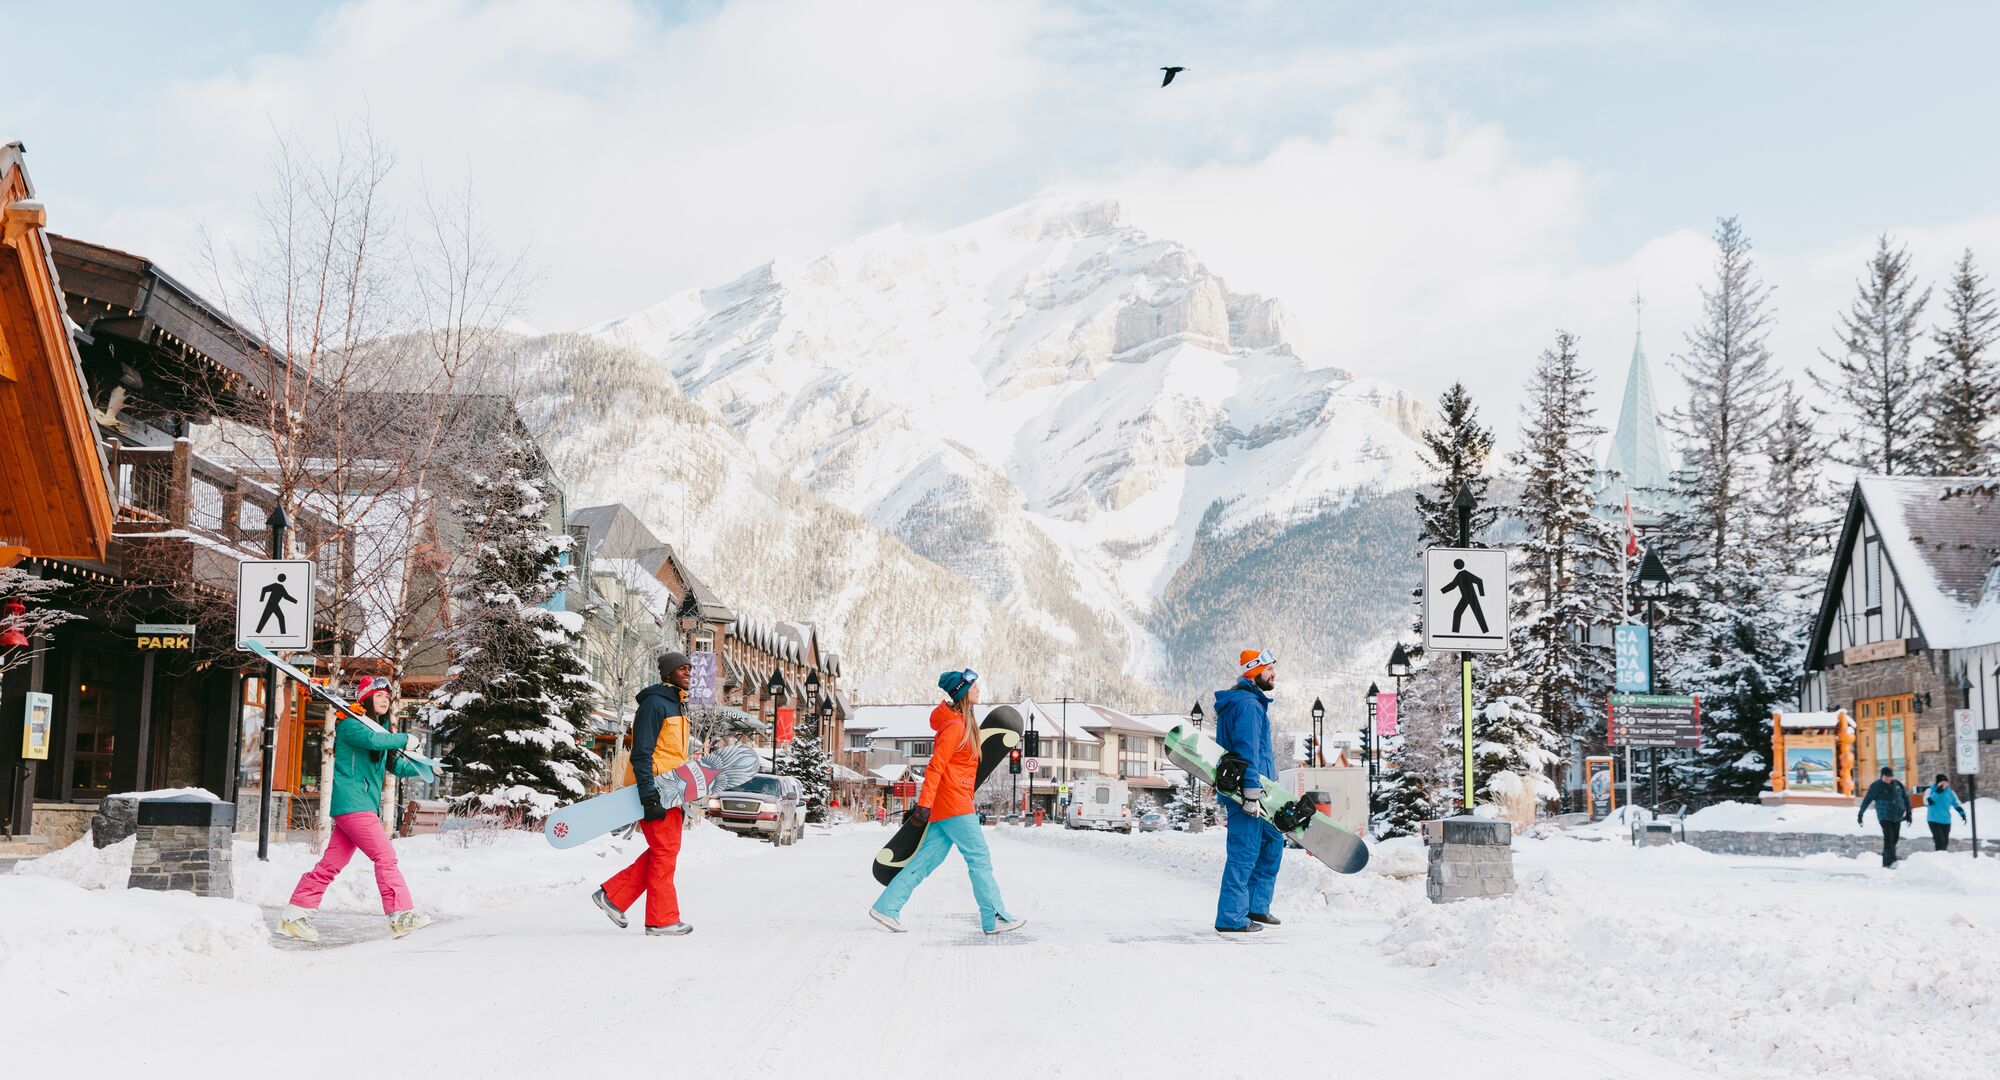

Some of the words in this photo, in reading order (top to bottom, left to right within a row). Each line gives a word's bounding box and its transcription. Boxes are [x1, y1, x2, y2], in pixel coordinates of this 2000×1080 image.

[1616, 630, 1638, 642] CA
[137, 637, 190, 649] PARK
[1616, 643, 1639, 656] NA
[1616, 657, 1640, 670] DA
[1616, 670, 1646, 684] 150
[722, 709, 745, 722] SHOPS
